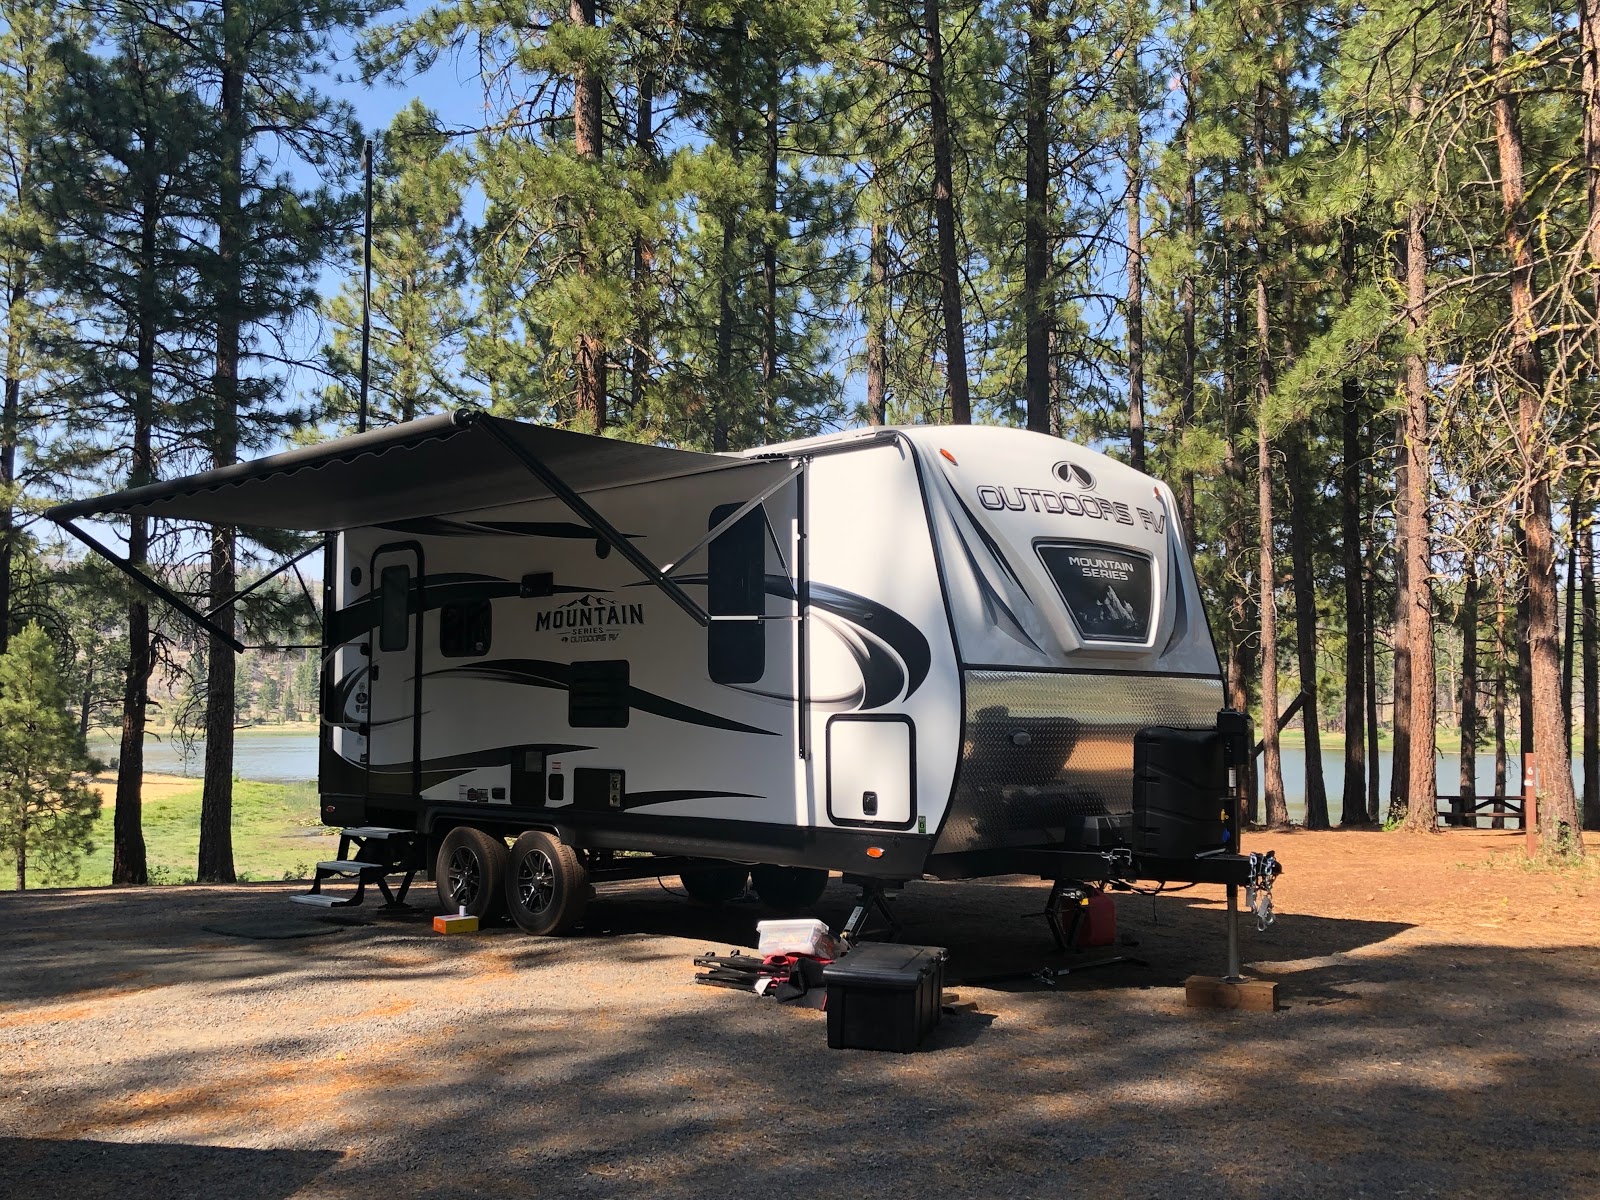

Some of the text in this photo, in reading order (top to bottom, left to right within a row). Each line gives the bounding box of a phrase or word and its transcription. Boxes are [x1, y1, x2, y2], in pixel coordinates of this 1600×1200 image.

[977, 485, 1166, 534] OUTDOORS RV
[1068, 556, 1134, 572] MOUNTAIN
[1081, 567, 1129, 581] SERIES
[535, 603, 644, 632] MOUNTAIN
[570, 634, 607, 643] OUTDOORS
[572, 627, 604, 635] SERIES
